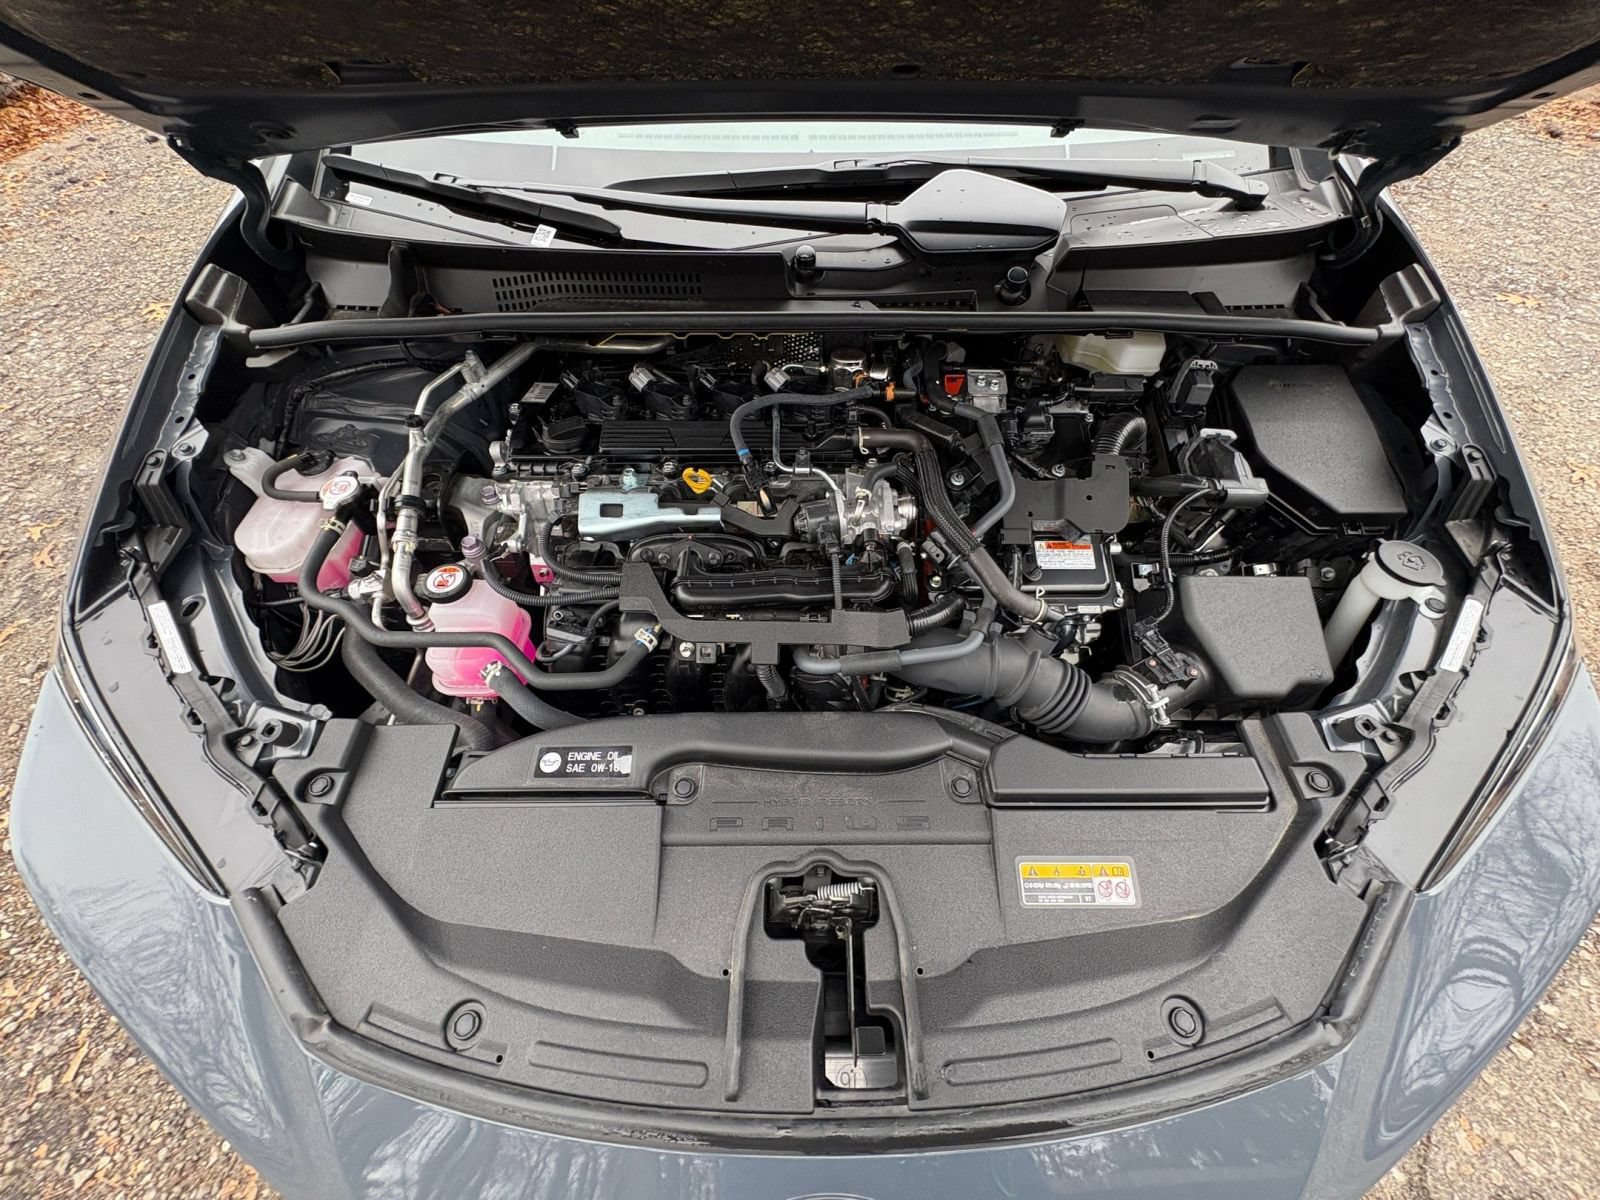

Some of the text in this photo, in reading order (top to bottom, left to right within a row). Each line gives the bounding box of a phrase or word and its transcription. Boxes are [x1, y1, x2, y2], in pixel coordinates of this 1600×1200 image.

[567, 751, 621, 761] ENGINE OIL
[565, 763, 586, 773] SAE
[709, 815, 931, 831] PRIUS
